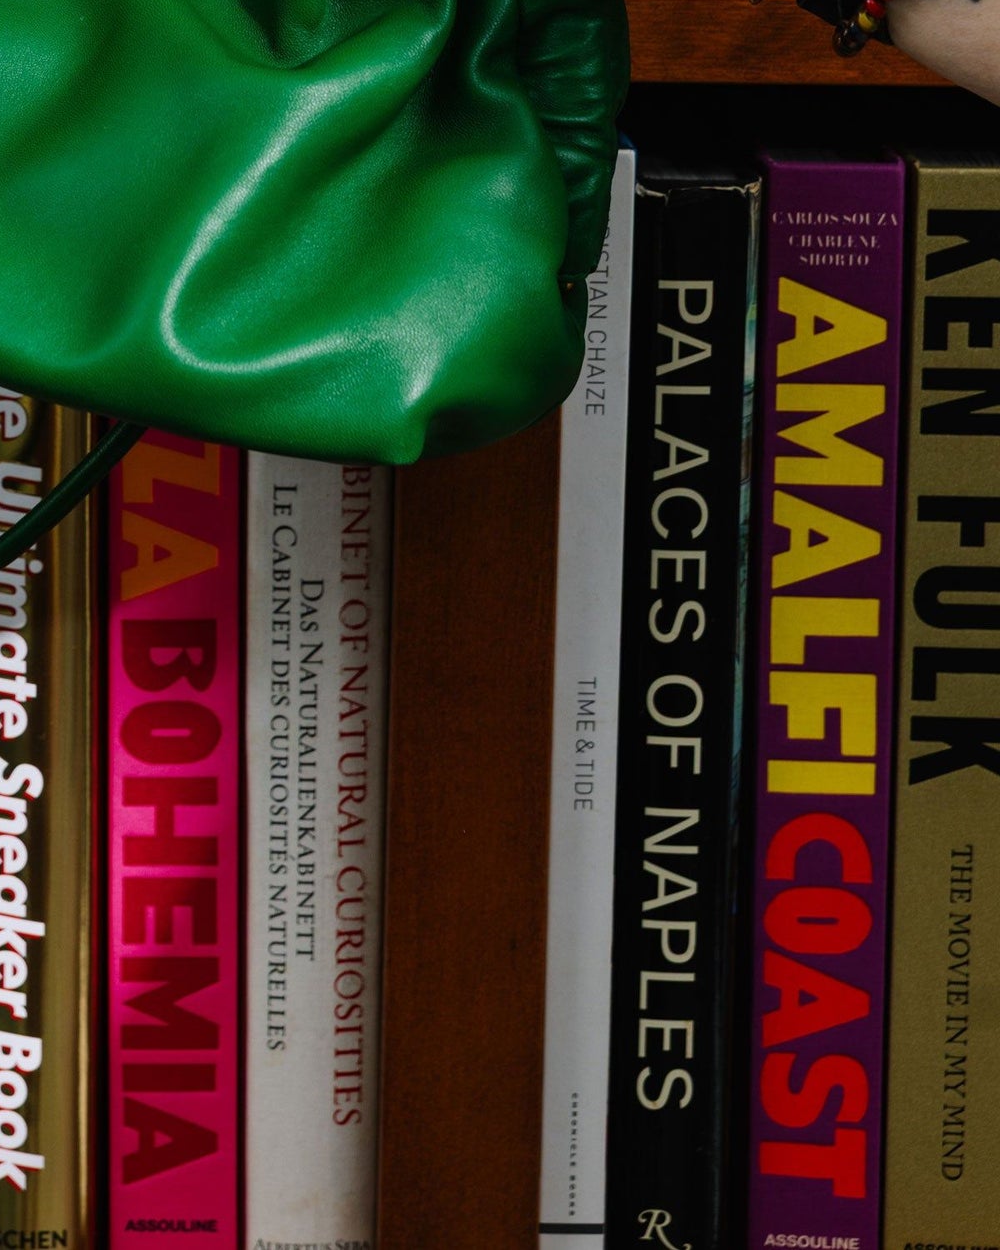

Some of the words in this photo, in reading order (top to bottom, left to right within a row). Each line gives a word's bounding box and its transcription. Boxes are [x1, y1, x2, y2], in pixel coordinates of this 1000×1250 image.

[771, 210, 839, 227] CARLOS
[841, 211, 899, 227] SOUZA
[788, 233, 881, 250] CHARLENE
[798, 253, 870, 268] SHORTO
[584, 330, 608, 416] CHAIZE
[647, 279, 714, 645] PALACES
[766, 275, 888, 795] AMALFI
[271, 525, 298, 644] CABINET
[299, 579, 324, 632] DAS
[339, 593, 371, 649] OF
[908, 495, 1000, 786] FULK
[269, 660, 290, 707] DES
[575, 676, 597, 732] TIME
[336, 664, 370, 859] NATURAL
[575, 738, 595, 754] &
[645, 674, 704, 775] OF
[295, 641, 324, 961] NATURALIENKABINETT
[573, 759, 595, 811] TIDE
[118, 618, 223, 1186] BOHEMIA
[947, 844, 974, 904] THE
[266, 883, 289, 1052] NATURELLES
[332, 866, 367, 1127] CURIOSITIES
[635, 806, 701, 1111] NAPLES
[945, 912, 972, 1008] MOVIE
[758, 811, 874, 1200] COAST
[944, 1016, 970, 1047] IN
[942, 1054, 969, 1100] MY
[940, 1106, 967, 1184] MIND
[124, 1218, 219, 1234] ASSOULINE
[763, 1232, 860, 1250] ASSOULINE
